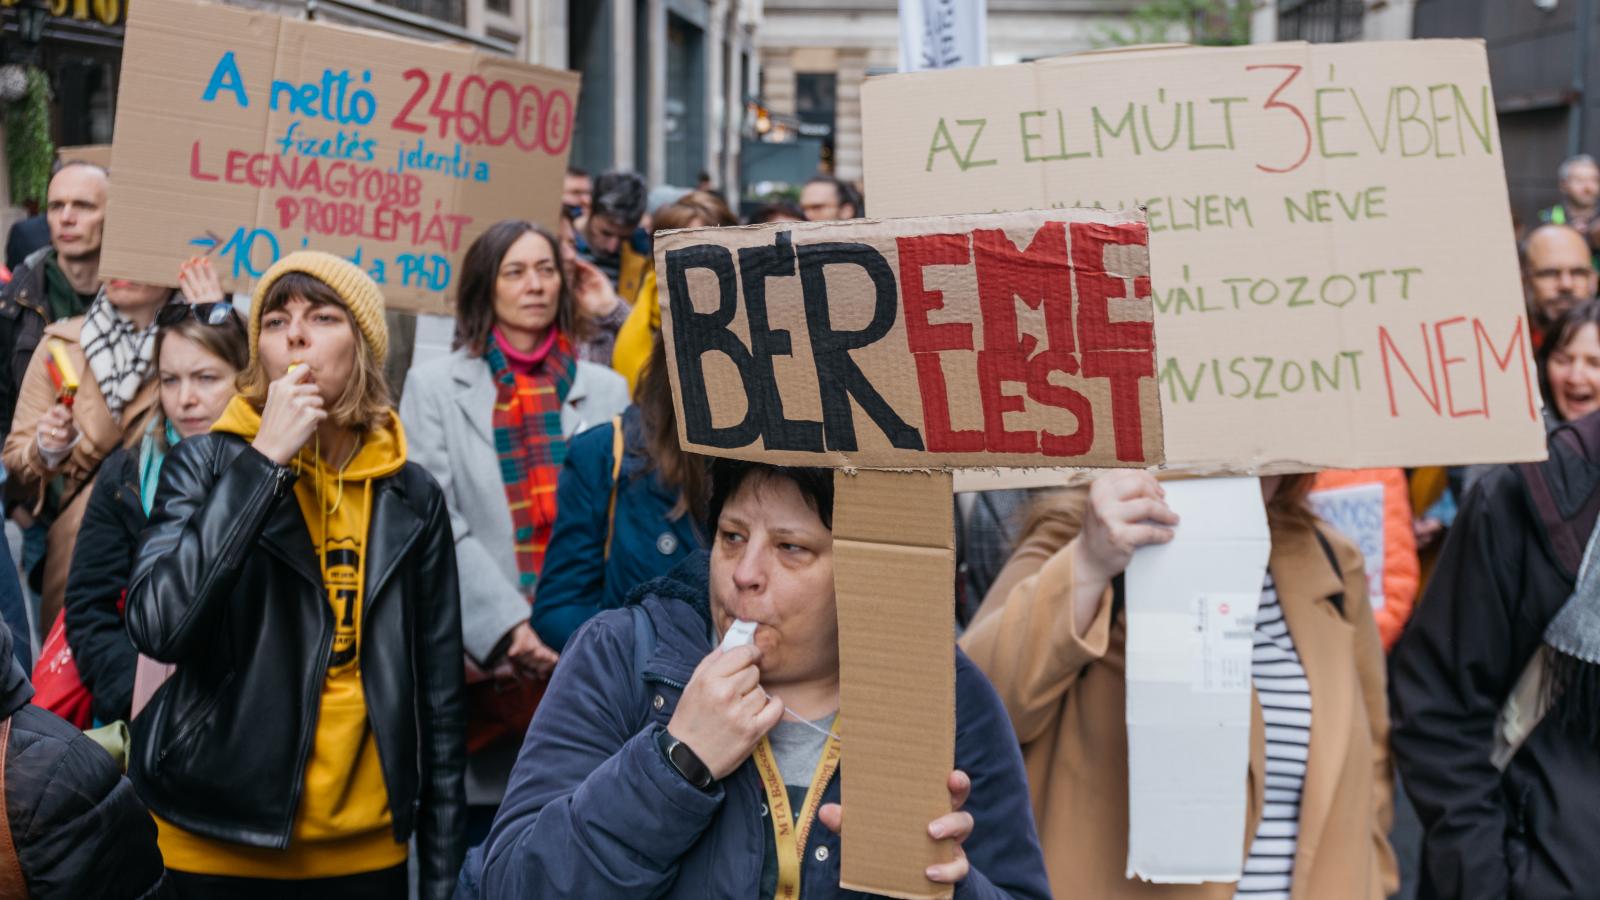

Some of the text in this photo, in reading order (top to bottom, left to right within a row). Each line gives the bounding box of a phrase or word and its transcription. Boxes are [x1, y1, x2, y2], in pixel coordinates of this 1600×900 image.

[202, 51, 248, 108] A
[269, 68, 376, 125] nettó
[925, 63, 1493, 173] AZ ELMÚLT 3 ÉVBEN
[189, 139, 423, 208] LEGNAGYOBB
[276, 121, 377, 161] fizetés
[1284, 186, 1387, 223] NEVE
[395, 253, 451, 292] PhD
[1378, 314, 1538, 422] NEM
